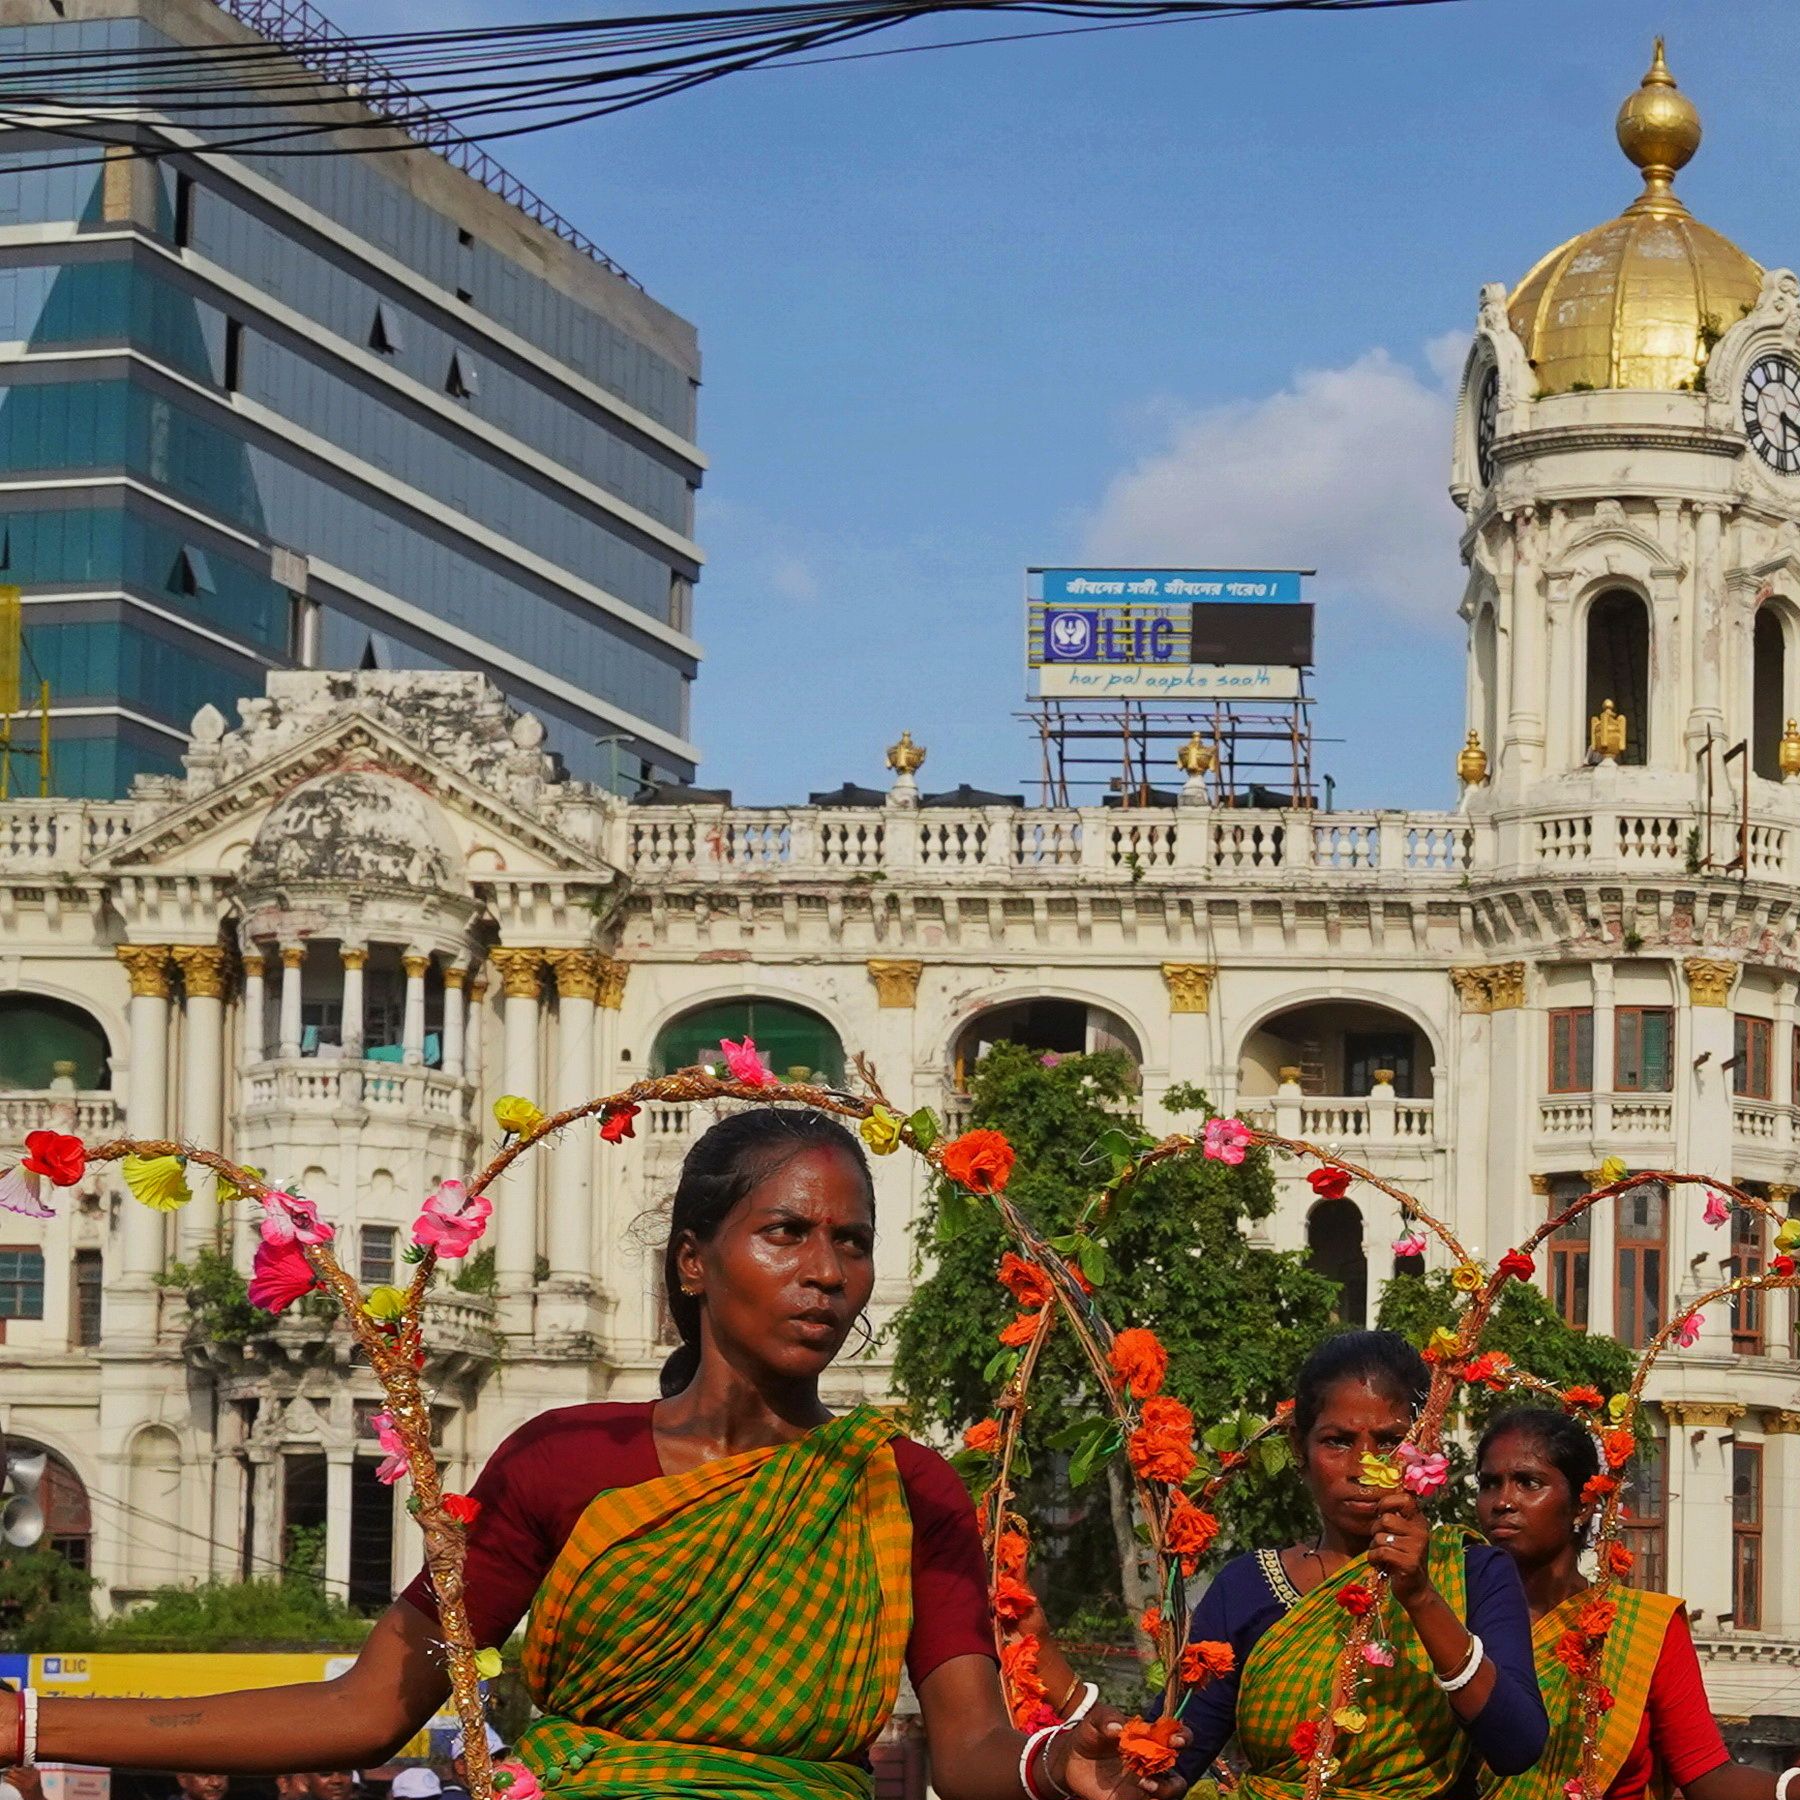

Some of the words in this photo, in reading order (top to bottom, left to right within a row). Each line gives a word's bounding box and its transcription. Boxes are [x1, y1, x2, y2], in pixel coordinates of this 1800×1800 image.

[1106, 617, 1174, 660] LIC
[1069, 667, 1103, 685] har
[1103, 667, 1142, 692] pal
[1146, 667, 1209, 693] aapke
[1215, 666, 1271, 688] saath
[63, 1658, 87, 1673] LIC
